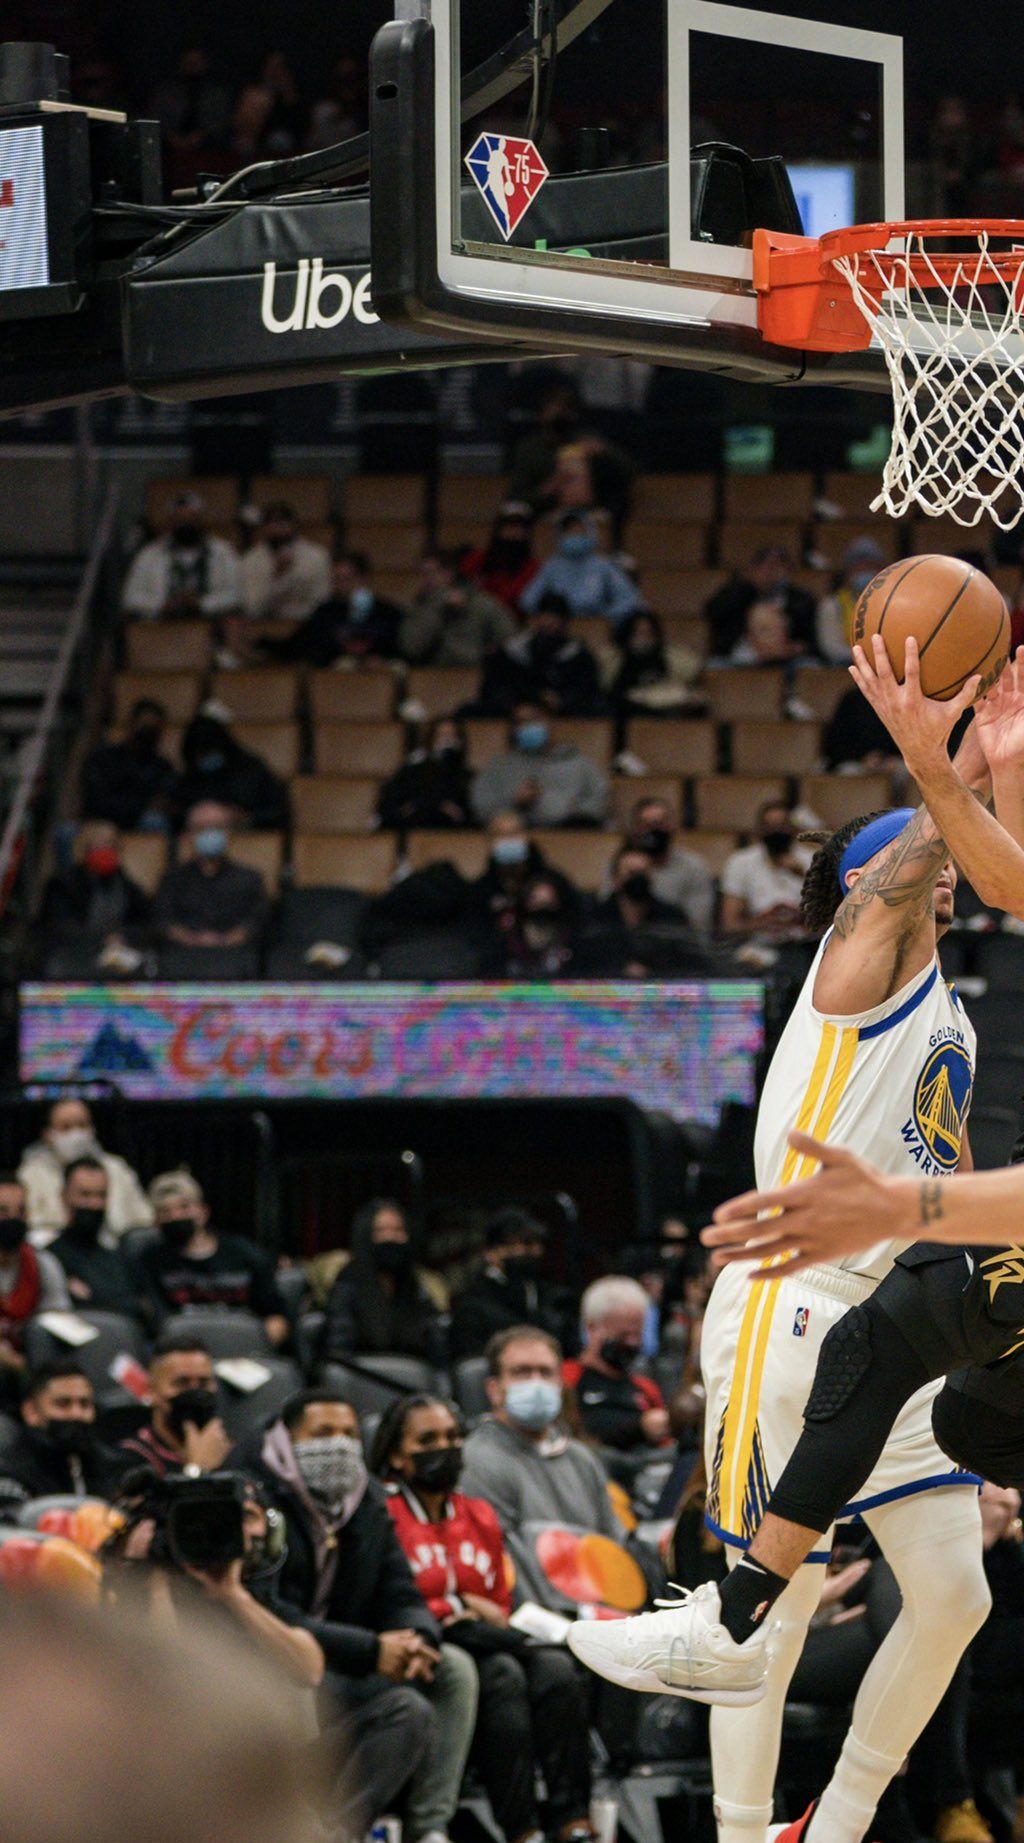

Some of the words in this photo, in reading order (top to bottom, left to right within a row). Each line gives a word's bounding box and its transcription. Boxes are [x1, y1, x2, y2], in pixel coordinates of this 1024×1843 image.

[513, 153, 531, 185] 75
[167, 1003, 375, 1081] Coors
[928, 1025, 966, 1047] GOLDEN
